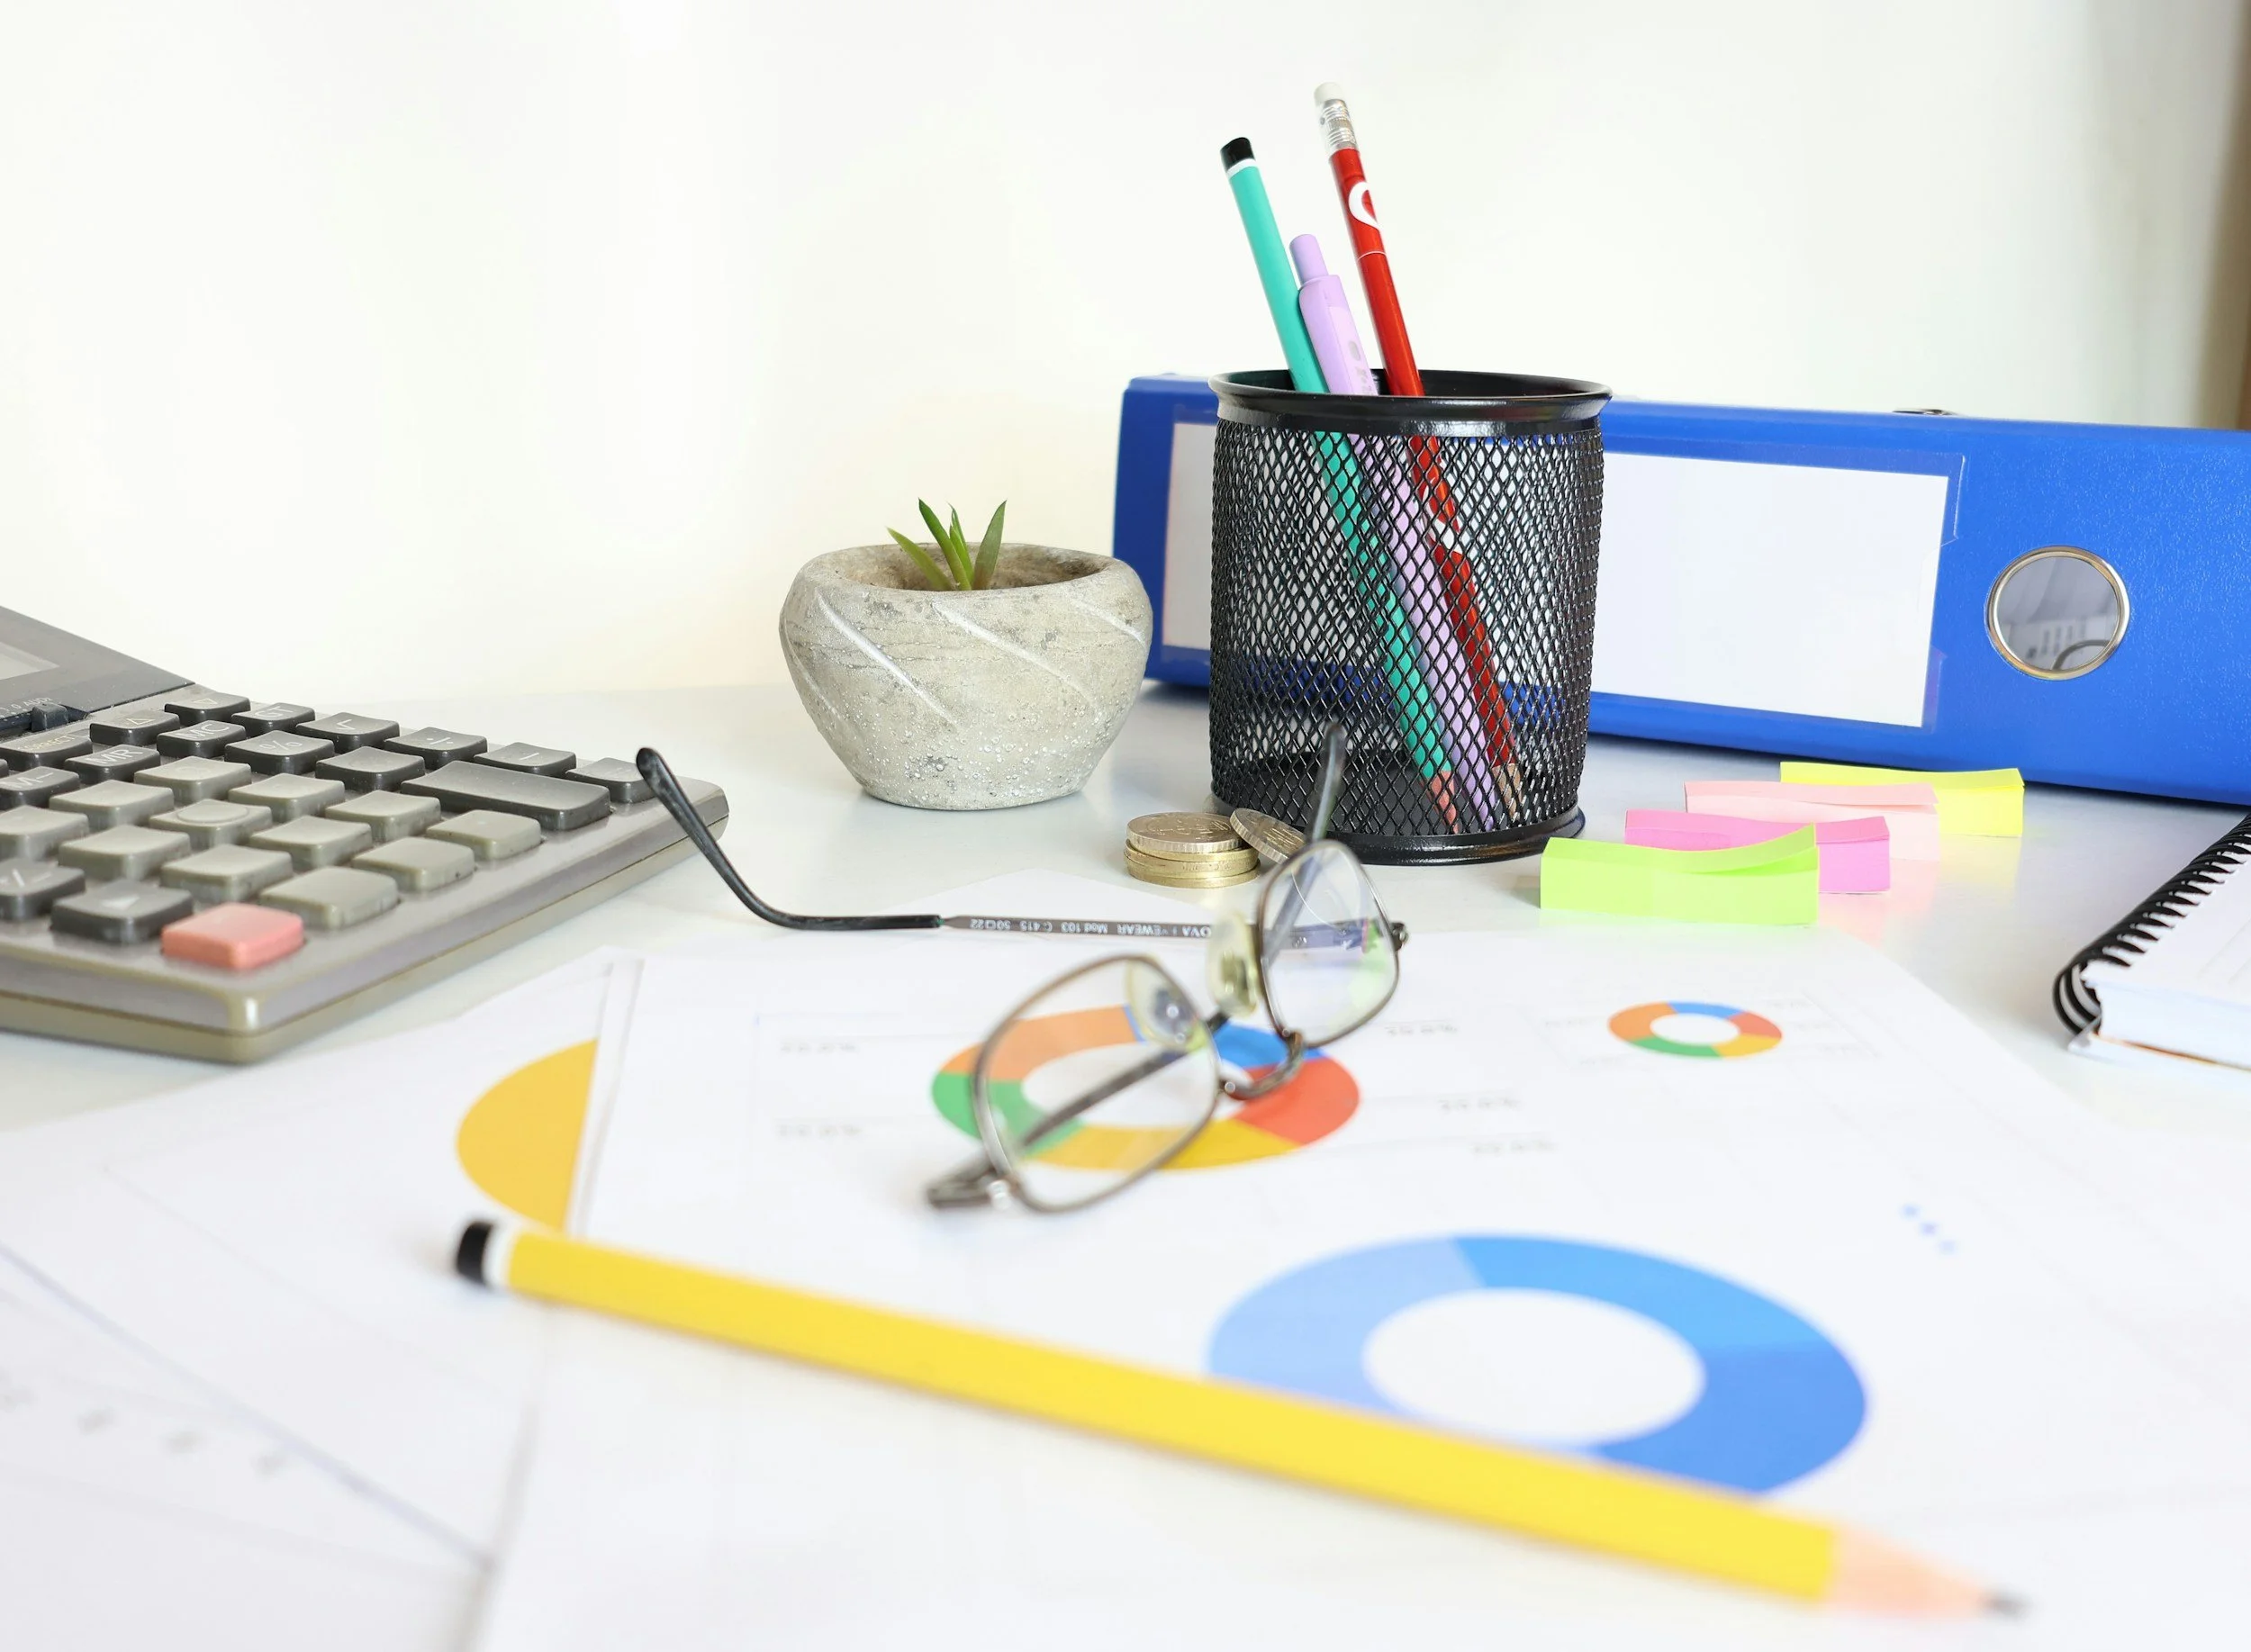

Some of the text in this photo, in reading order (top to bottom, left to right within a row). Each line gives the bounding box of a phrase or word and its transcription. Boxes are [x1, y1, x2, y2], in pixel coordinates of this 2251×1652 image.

[254, 705, 295, 718] GT
[174, 723, 231, 740] MC
[84, 748, 144, 765] MR
